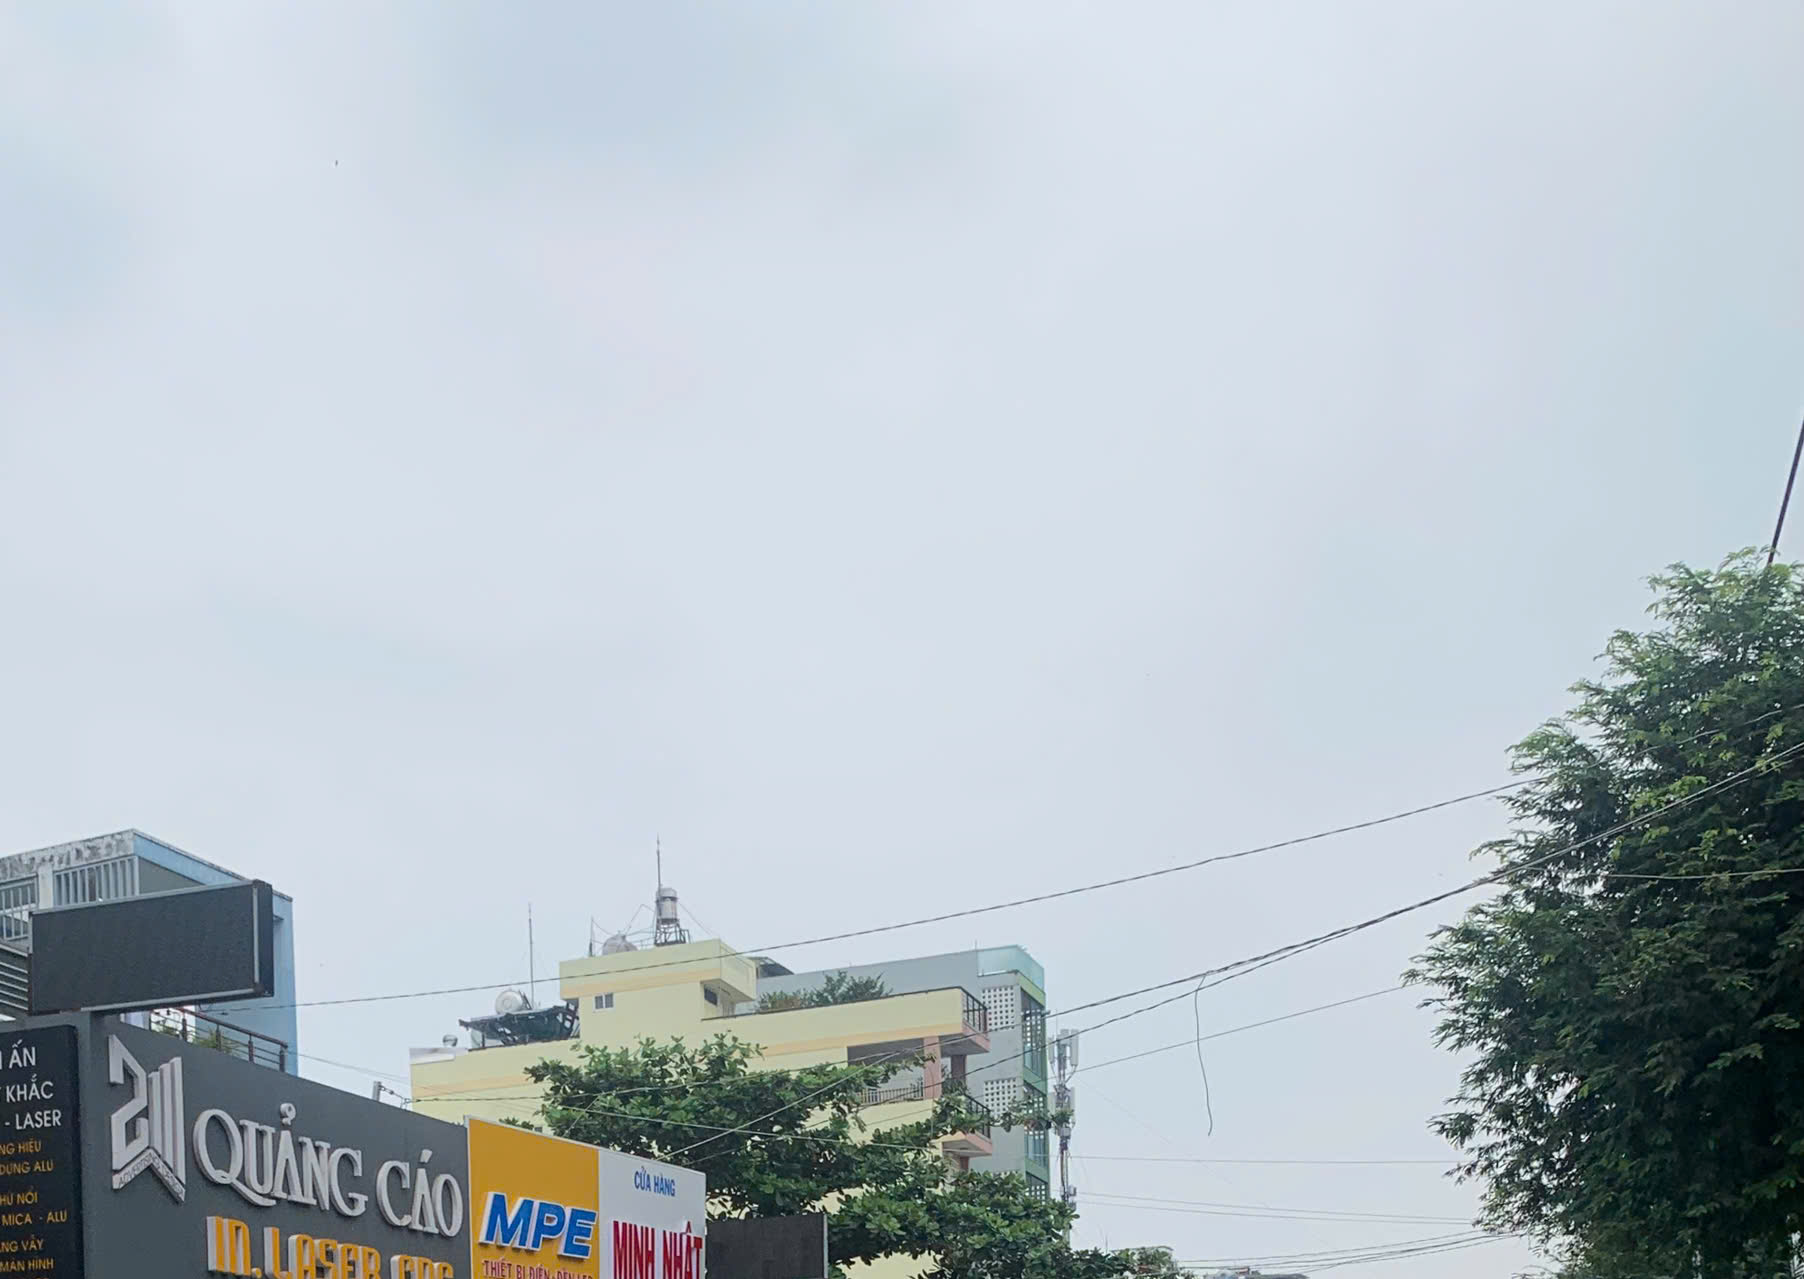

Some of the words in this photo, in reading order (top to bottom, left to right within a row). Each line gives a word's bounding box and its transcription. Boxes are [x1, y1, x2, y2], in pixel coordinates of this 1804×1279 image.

[9, 1039, 36, 1069] ẤN
[6, 1073, 54, 1103] KHẮC
[15, 1109, 61, 1130] LASER
[33, 1159, 54, 1172] ALU
[193, 1103, 368, 1216] QUẢNG
[376, 1149, 463, 1237] CÁO
[634, 1166, 651, 1191] CỬA
[653, 1176, 676, 1197] HÀNG
[46, 1210, 67, 1223] ALU
[479, 1192, 598, 1259] MPE
